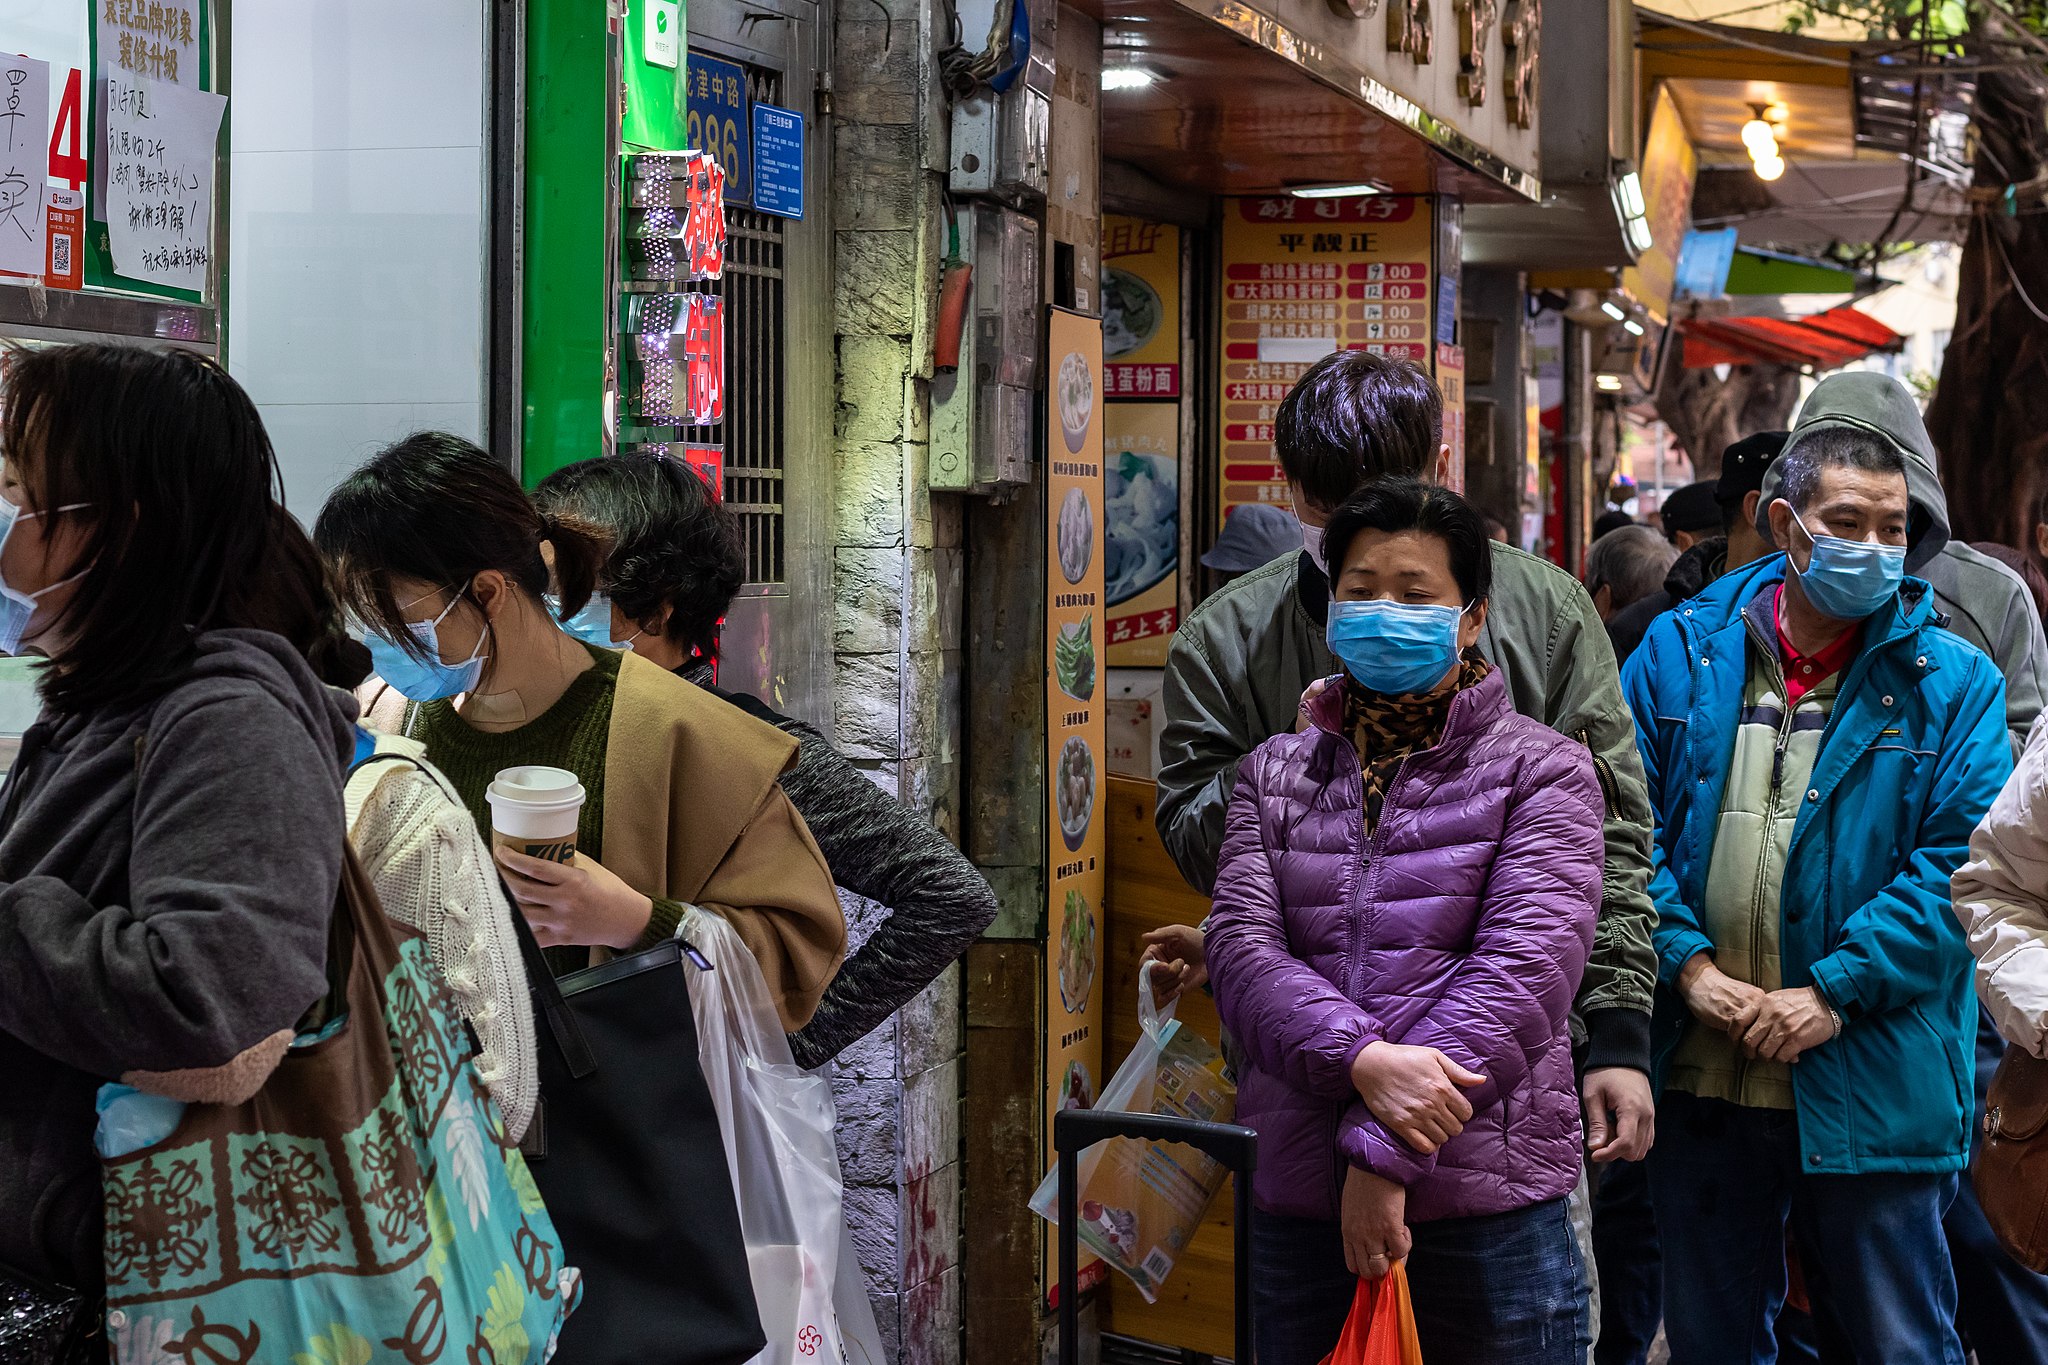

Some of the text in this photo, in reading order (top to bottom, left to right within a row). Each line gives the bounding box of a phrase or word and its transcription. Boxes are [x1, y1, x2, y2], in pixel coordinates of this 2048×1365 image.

[687, 109, 739, 189] 386
[1105, 611, 1172, 641] 品上市
